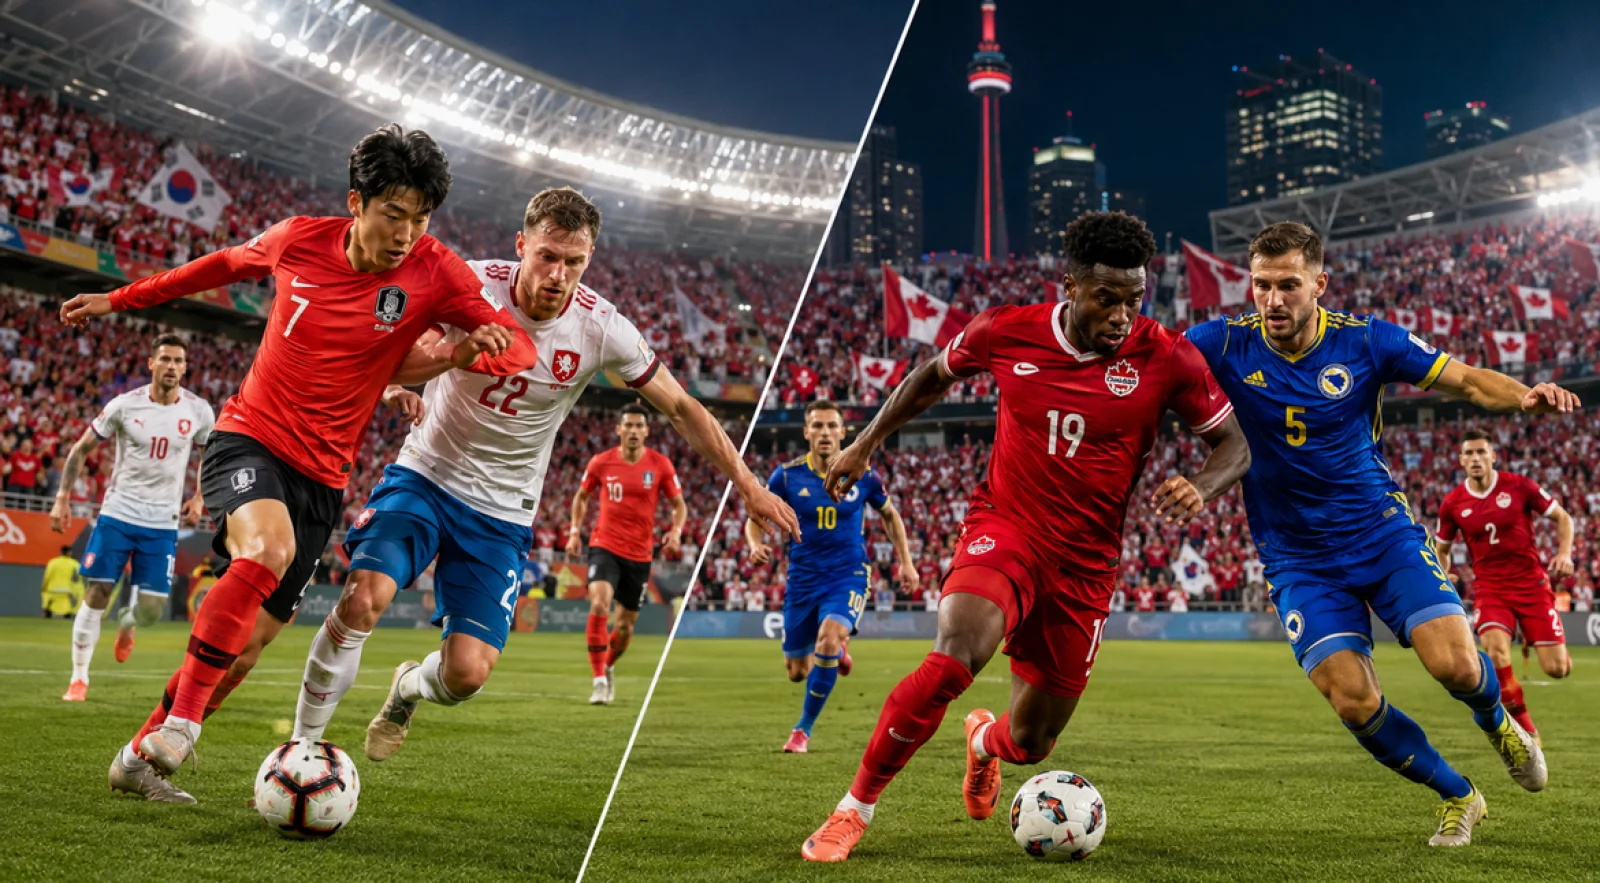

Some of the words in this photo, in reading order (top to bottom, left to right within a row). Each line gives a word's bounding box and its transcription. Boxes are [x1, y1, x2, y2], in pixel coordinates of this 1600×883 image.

[283, 293, 310, 338] 7
[479, 374, 529, 416] 22
[1046, 409, 1086, 459] 19
[1285, 406, 1308, 447] 5
[149, 436, 169, 460] 10
[606, 482, 623, 503] 10
[816, 506, 837, 530] 10
[1485, 522, 1500, 546] 2
[1419, 549, 1446, 581] 5
[848, 590, 864, 614] 10
